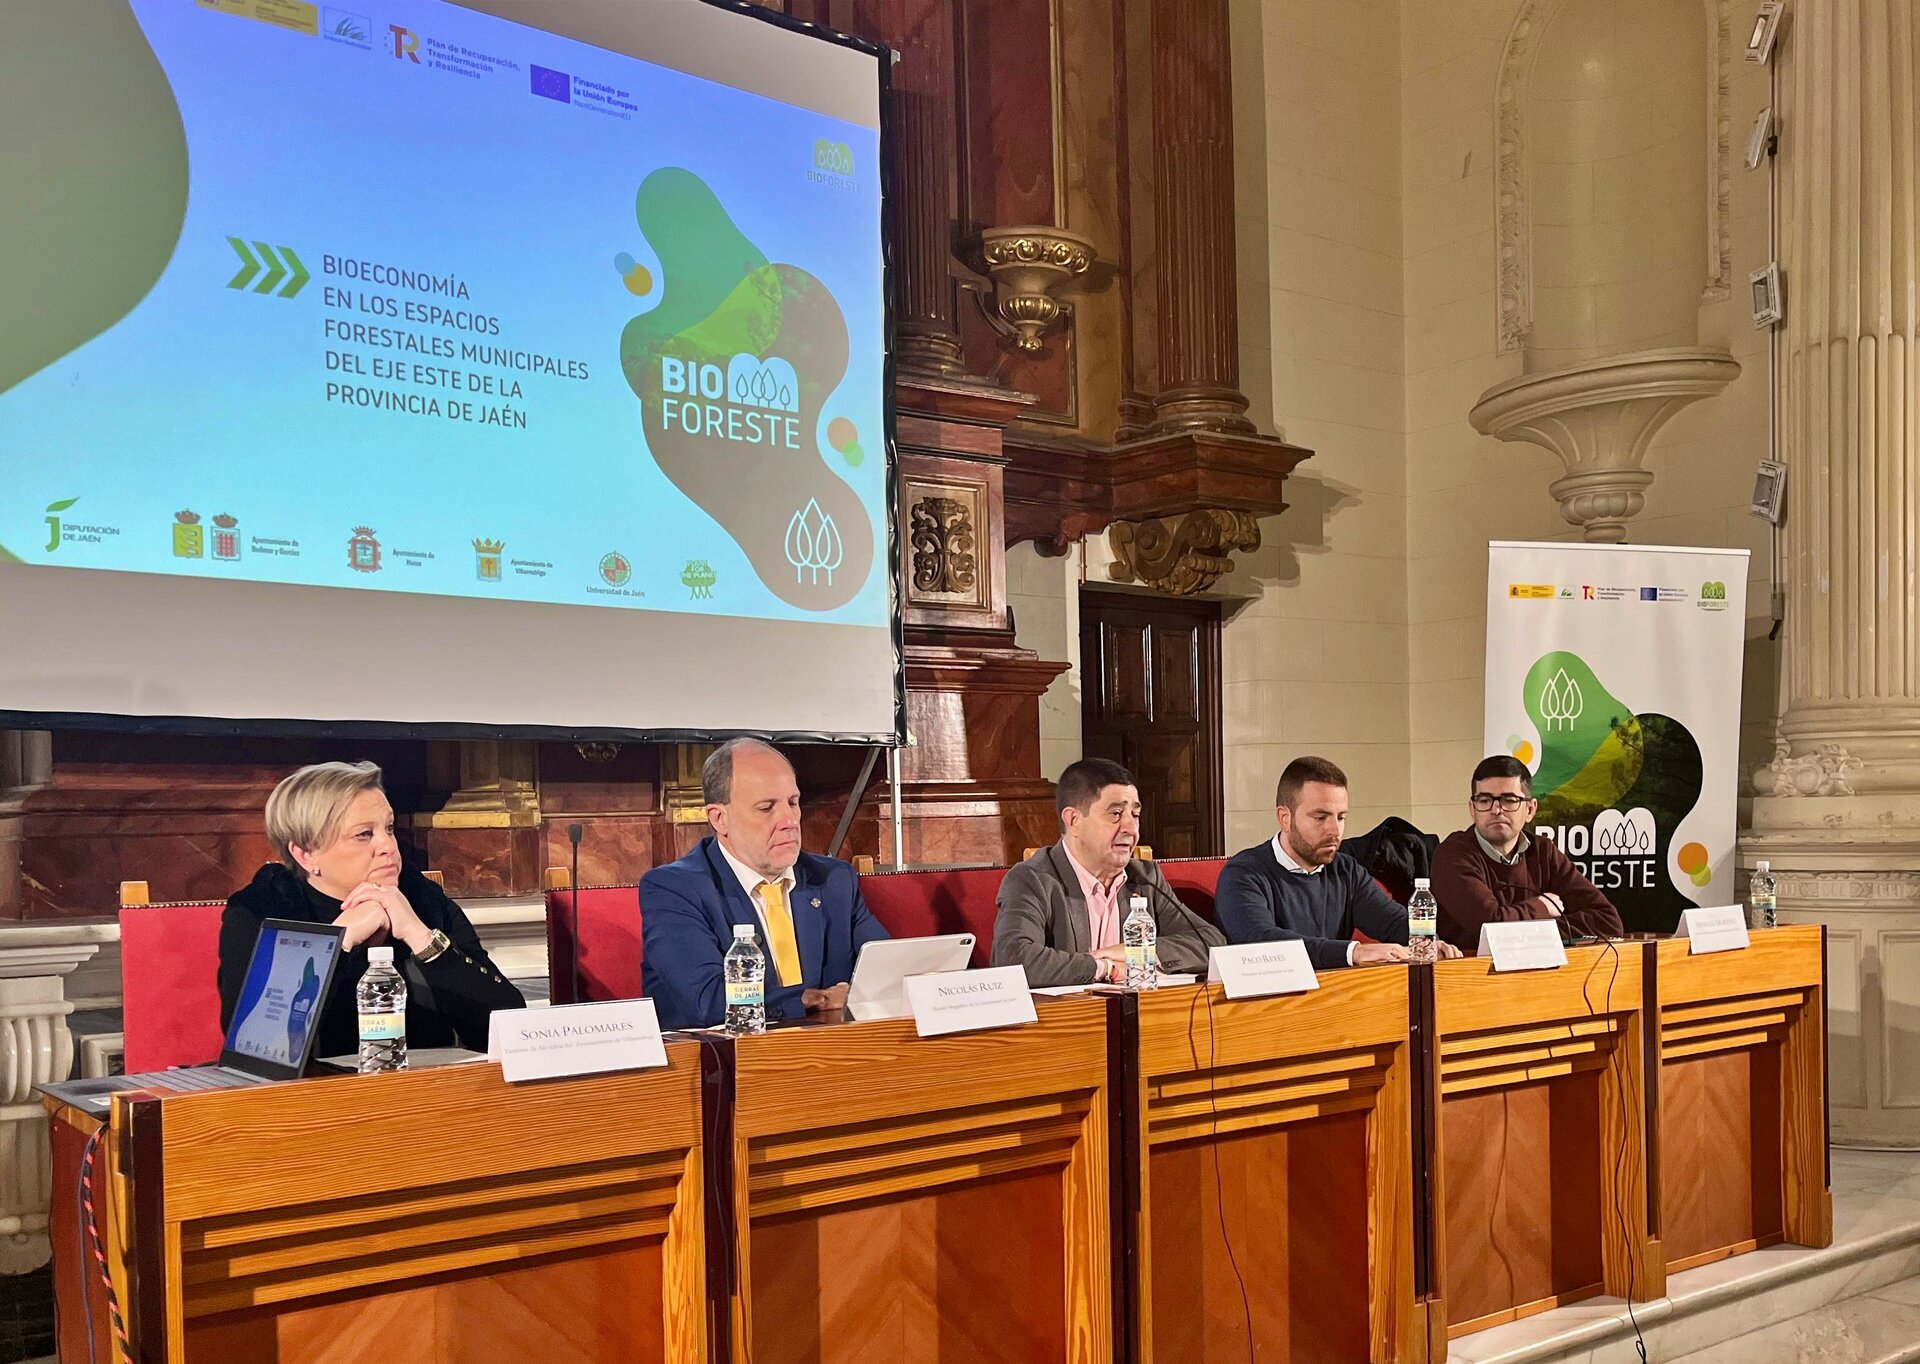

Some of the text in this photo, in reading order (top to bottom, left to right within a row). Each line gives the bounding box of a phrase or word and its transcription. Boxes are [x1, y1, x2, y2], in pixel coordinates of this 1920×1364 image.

[427, 38, 520, 72] Plan de Recuperación,
[427, 48, 494, 73] Transformación
[427, 60, 481, 80] y Resiliencia
[573, 76, 630, 98] Financiado por
[573, 86, 639, 112] la Unión Europea
[806, 170, 862, 194] BIOFORESTE
[323, 254, 470, 300] BIOECONOMÍA
[324, 287, 500, 335] EN LOS ESPACIOS
[325, 319, 589, 380] FORESTALES MUNICIPALES
[326, 351, 523, 399] DEL EJE ESTE DE LA
[662, 356, 724, 400] BIO
[326, 382, 527, 429] PROVINCIA DE JAÉN
[662, 398, 800, 450] FORESTE
[62, 524, 120, 535] DIPUTACIÓN
[62, 533, 102, 543] DE JAÉN
[586, 586, 622, 595] Universidad
[979, 981, 1004, 992] RUIZ
[520, 1020, 634, 1041] SONIA PALOMARES
